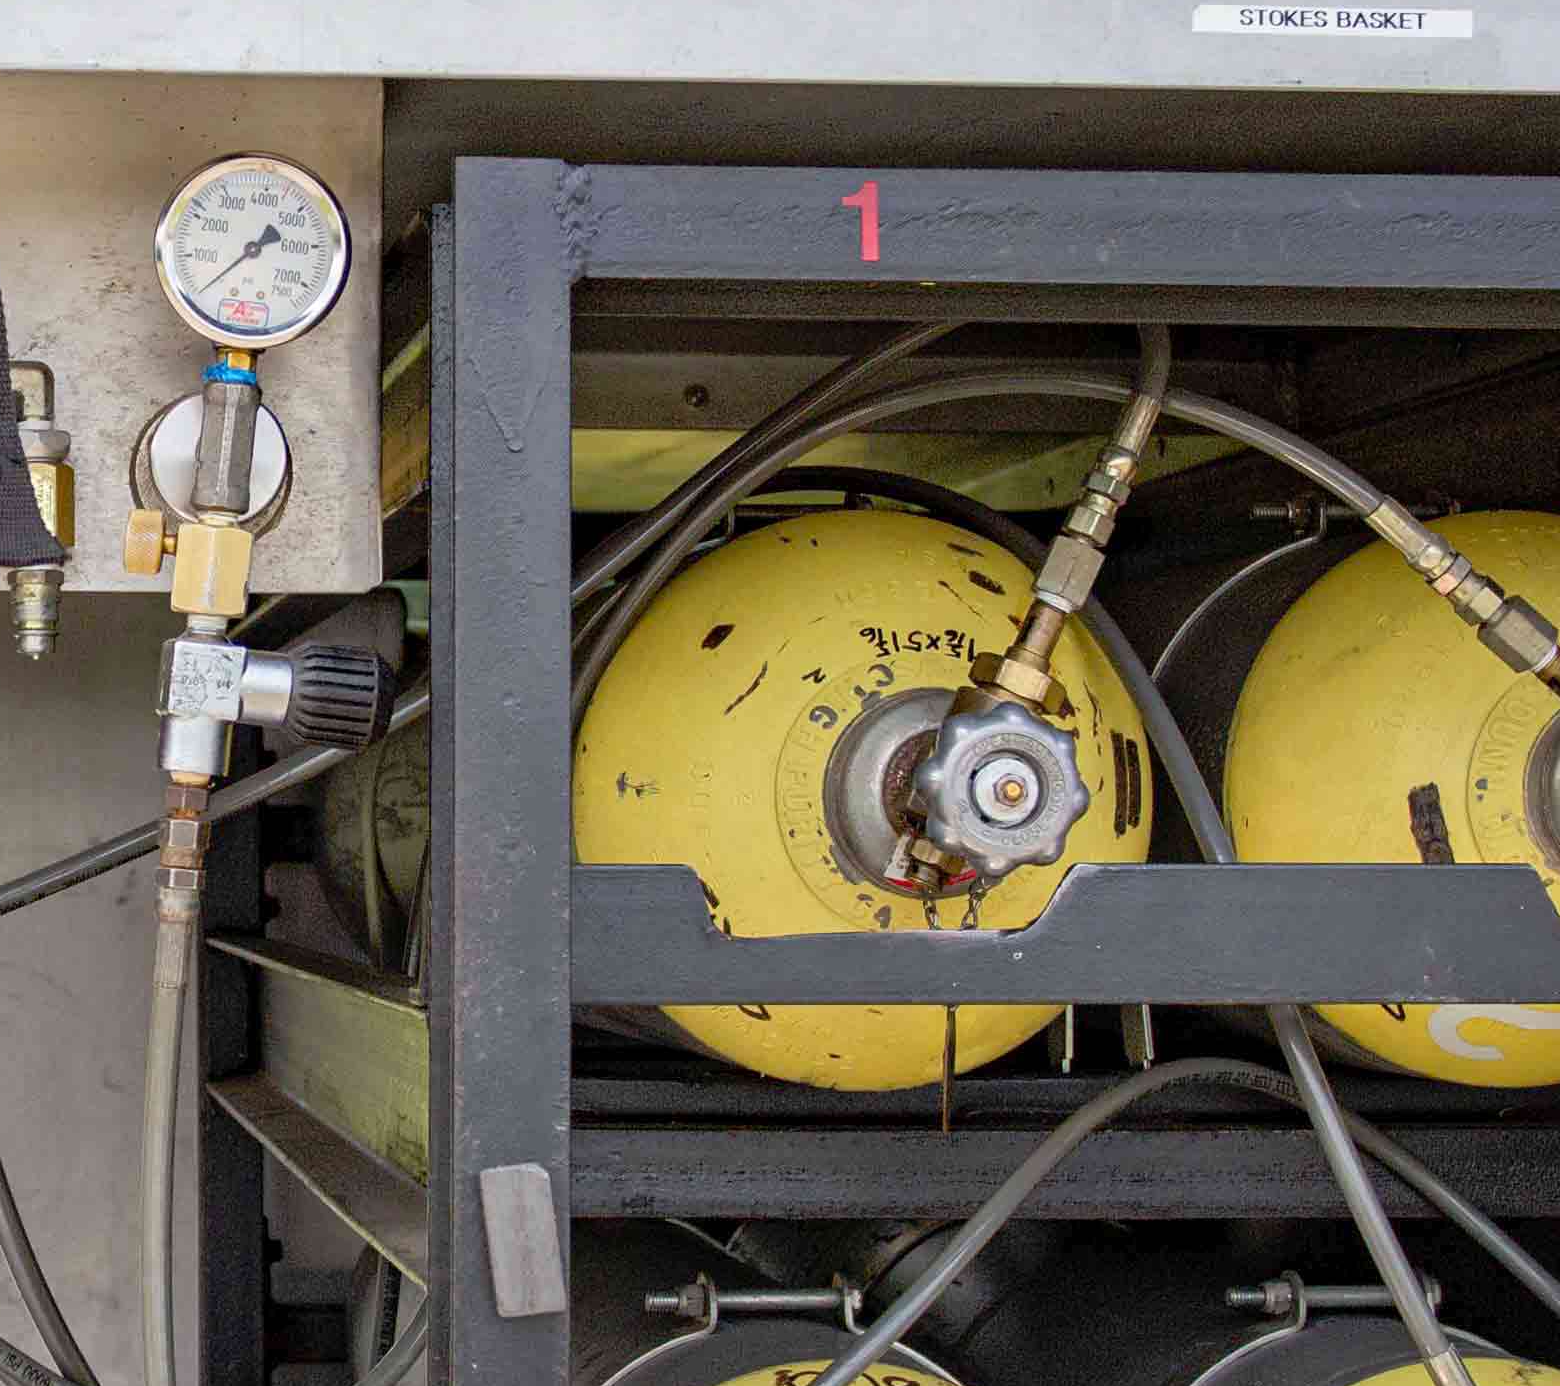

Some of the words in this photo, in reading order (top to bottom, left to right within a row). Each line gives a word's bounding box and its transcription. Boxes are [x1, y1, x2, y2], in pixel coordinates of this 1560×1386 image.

[1239, 8, 1329, 28] STOKES
[1336, 10, 1428, 30] BASKET
[218, 195, 246, 211] 3000
[251, 192, 278, 208] 4000
[201, 217, 229, 233] 2000
[278, 212, 305, 228] 5000
[841, 180, 880, 262] 1
[281, 238, 309, 255] 6000
[193, 248, 218, 262] 1000
[274, 269, 301, 284] 7000
